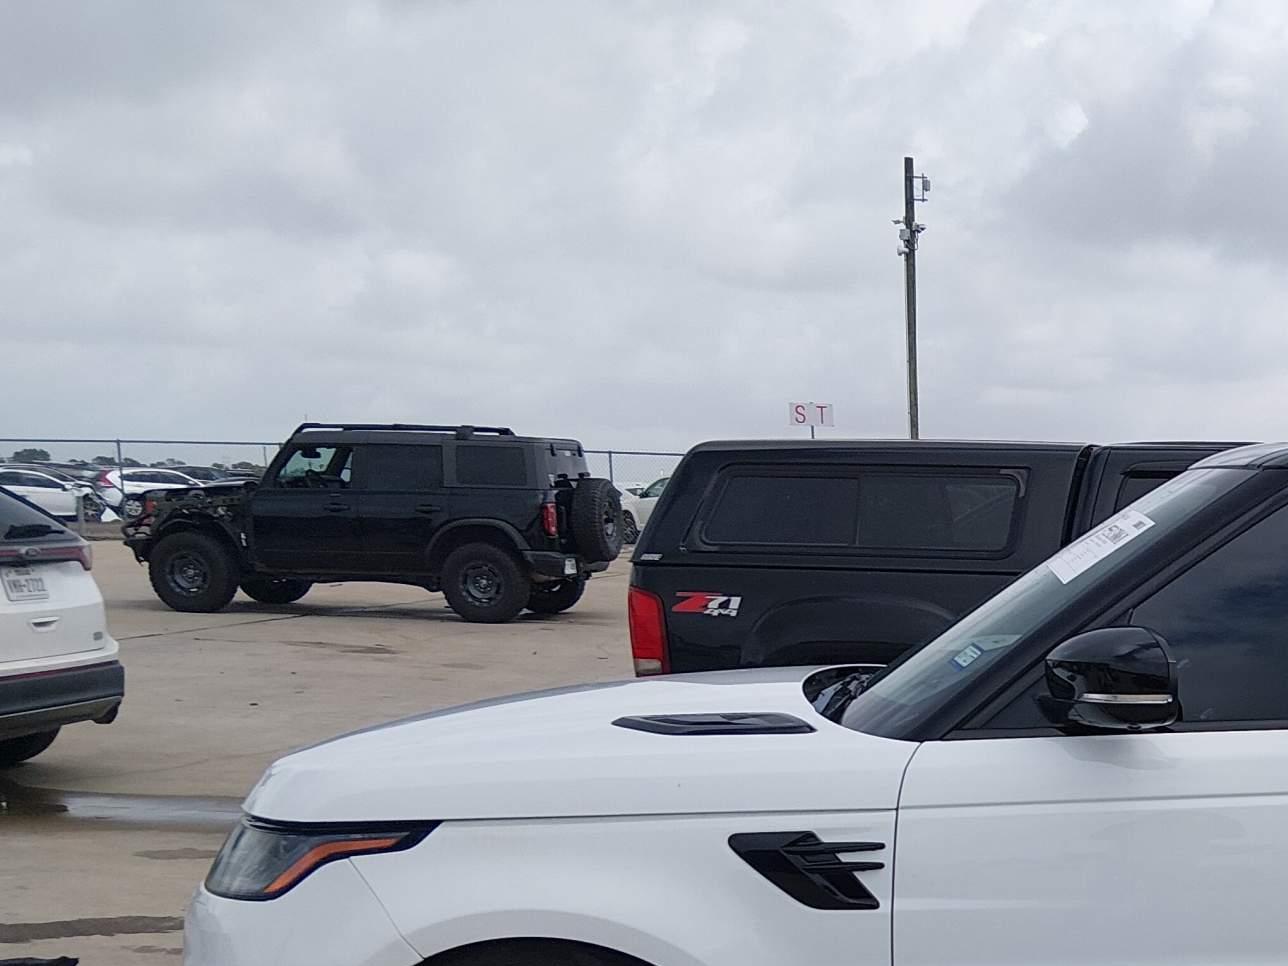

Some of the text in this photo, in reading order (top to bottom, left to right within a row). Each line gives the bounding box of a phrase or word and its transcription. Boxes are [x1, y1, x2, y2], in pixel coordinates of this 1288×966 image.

[795, 404, 828, 424] S T
[672, 592, 742, 613] Z71
